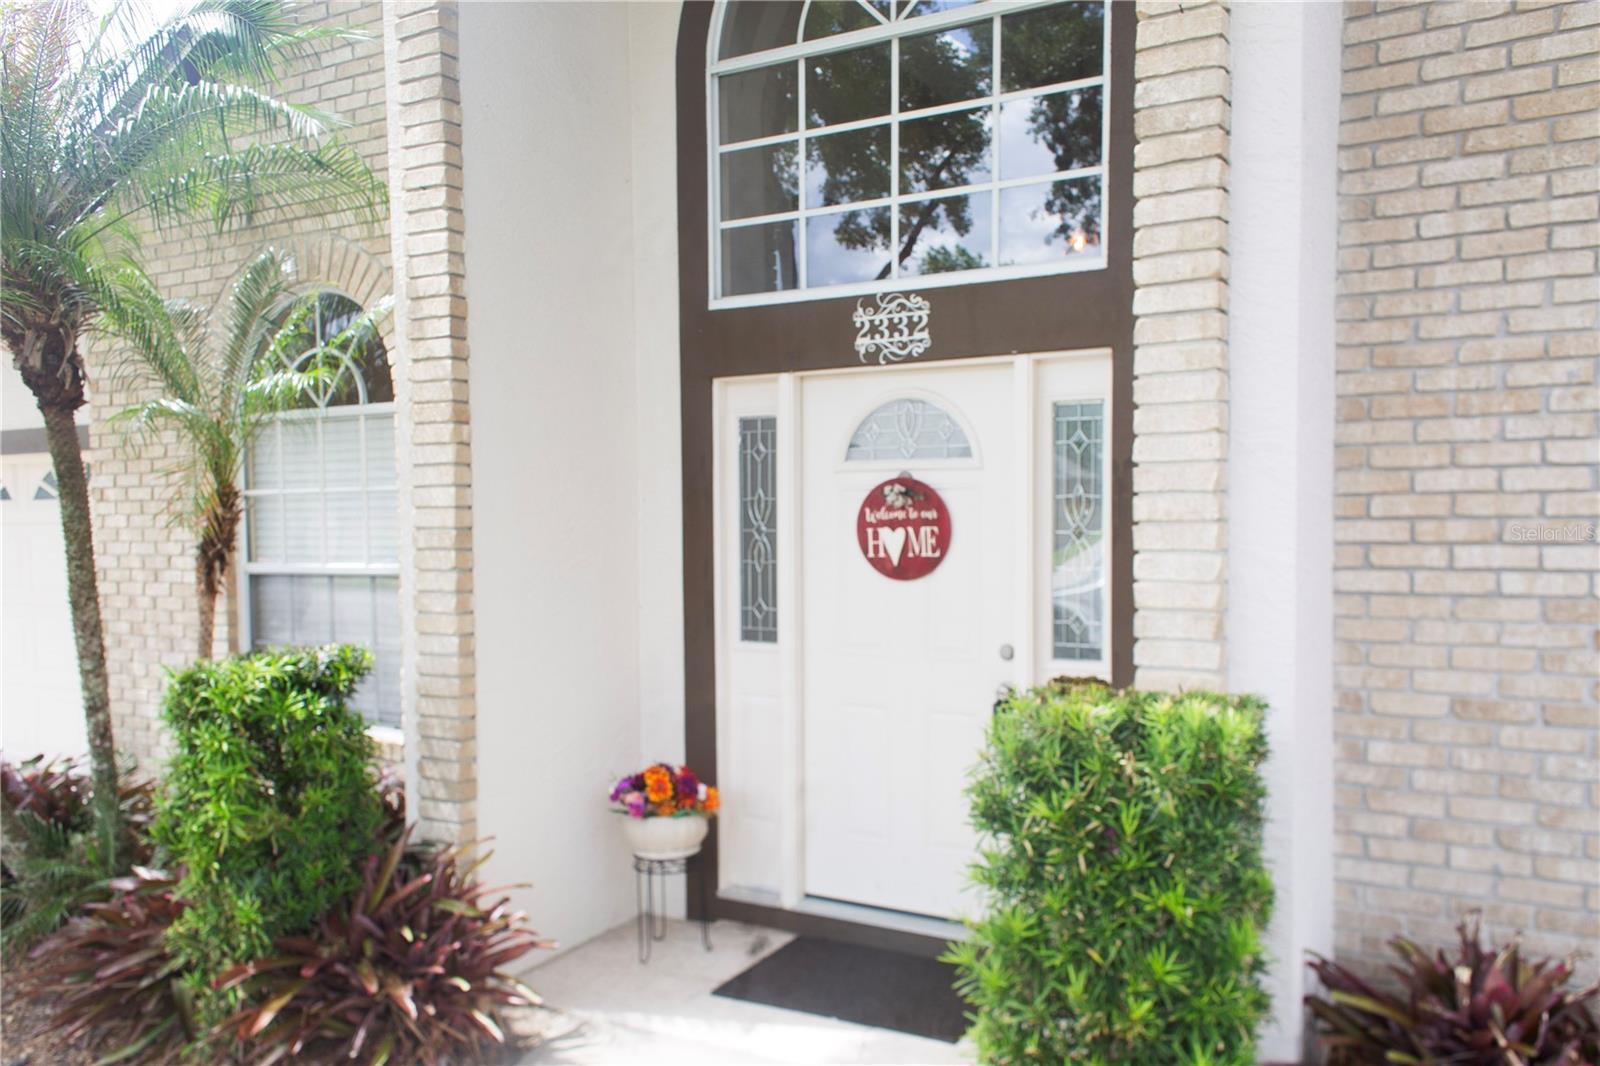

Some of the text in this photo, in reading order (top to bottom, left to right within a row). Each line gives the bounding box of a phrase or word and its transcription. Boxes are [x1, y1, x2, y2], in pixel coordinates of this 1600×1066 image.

[854, 314, 929, 341] 2332
[865, 507, 906, 523] Welcome
[907, 507, 918, 519] to
